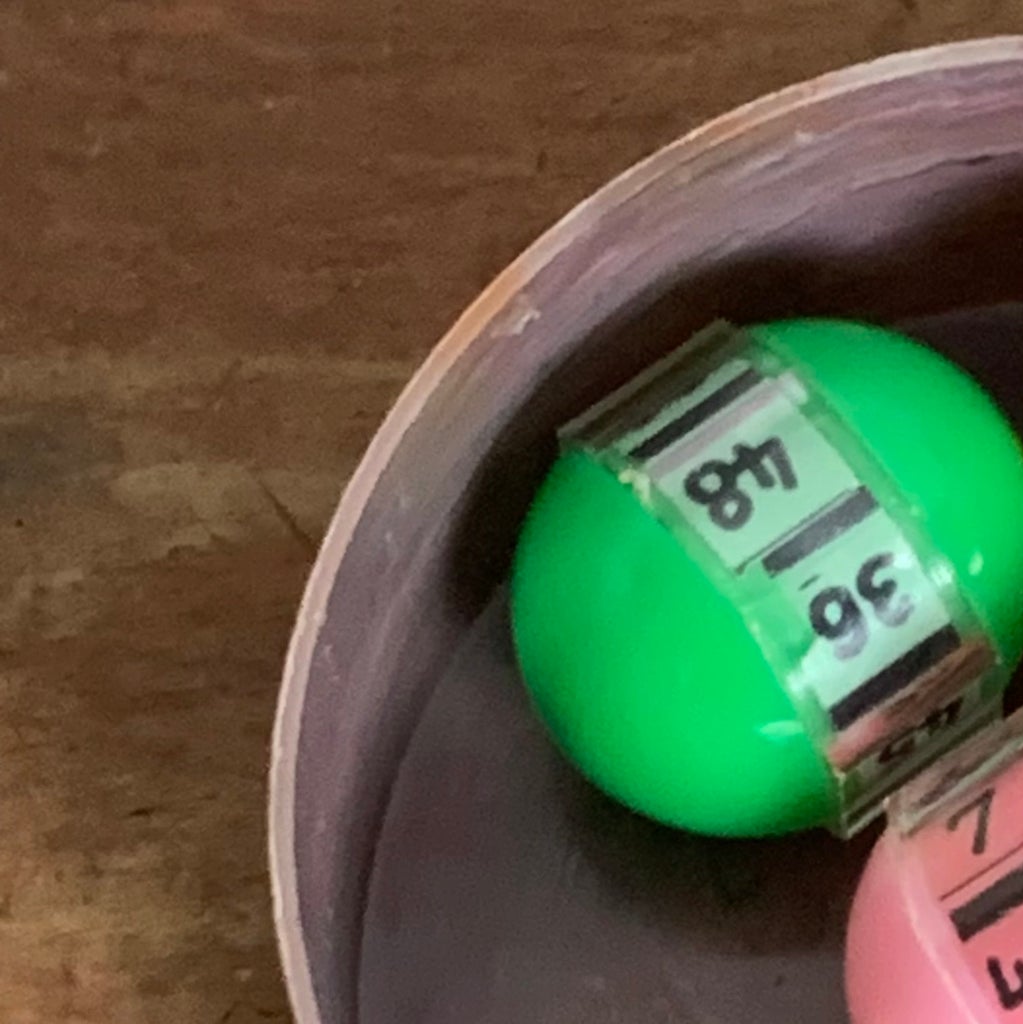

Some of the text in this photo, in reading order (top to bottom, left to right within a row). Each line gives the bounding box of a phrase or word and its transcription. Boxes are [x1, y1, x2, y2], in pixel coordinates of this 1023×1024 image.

[683, 436, 798, 531] 48
[808, 552, 916, 660] 36
[946, 788, 996, 855] 7
